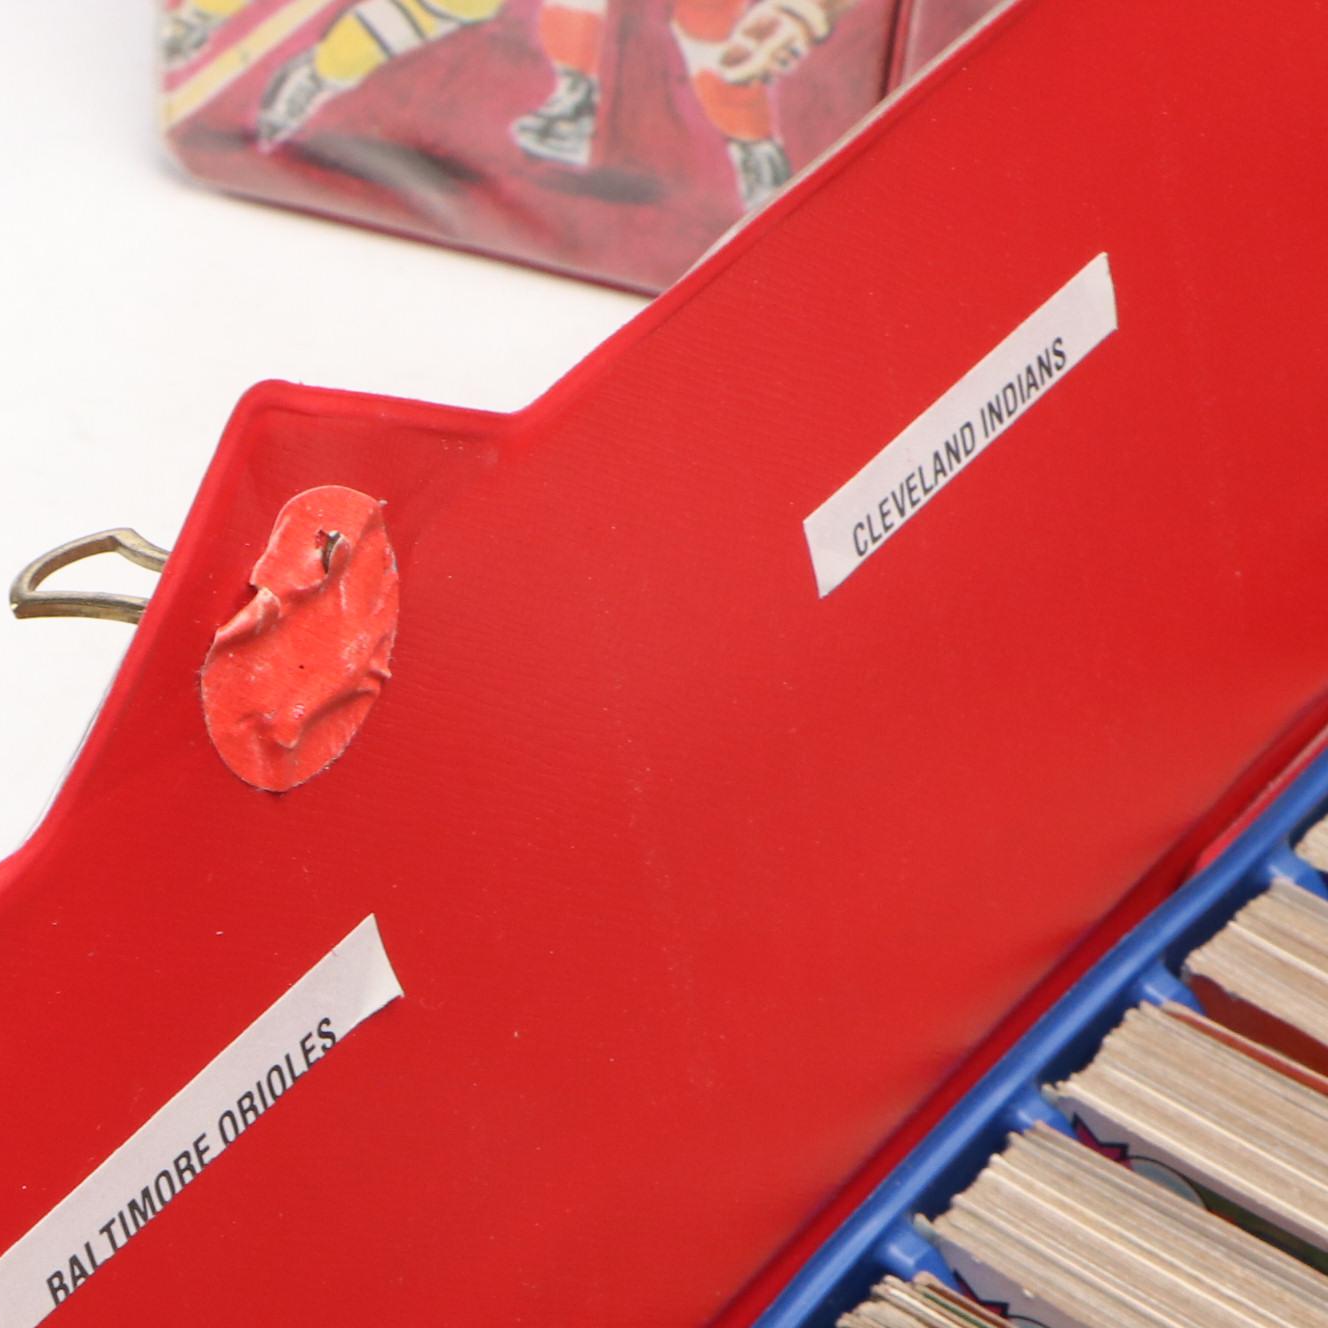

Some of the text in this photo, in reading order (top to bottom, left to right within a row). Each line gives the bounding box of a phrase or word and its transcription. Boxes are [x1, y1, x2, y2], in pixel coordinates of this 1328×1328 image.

[852, 337, 1067, 557] CLEVELAND INDIANS
[46, 1017, 337, 1307] BALTIMORE ORIOLES
